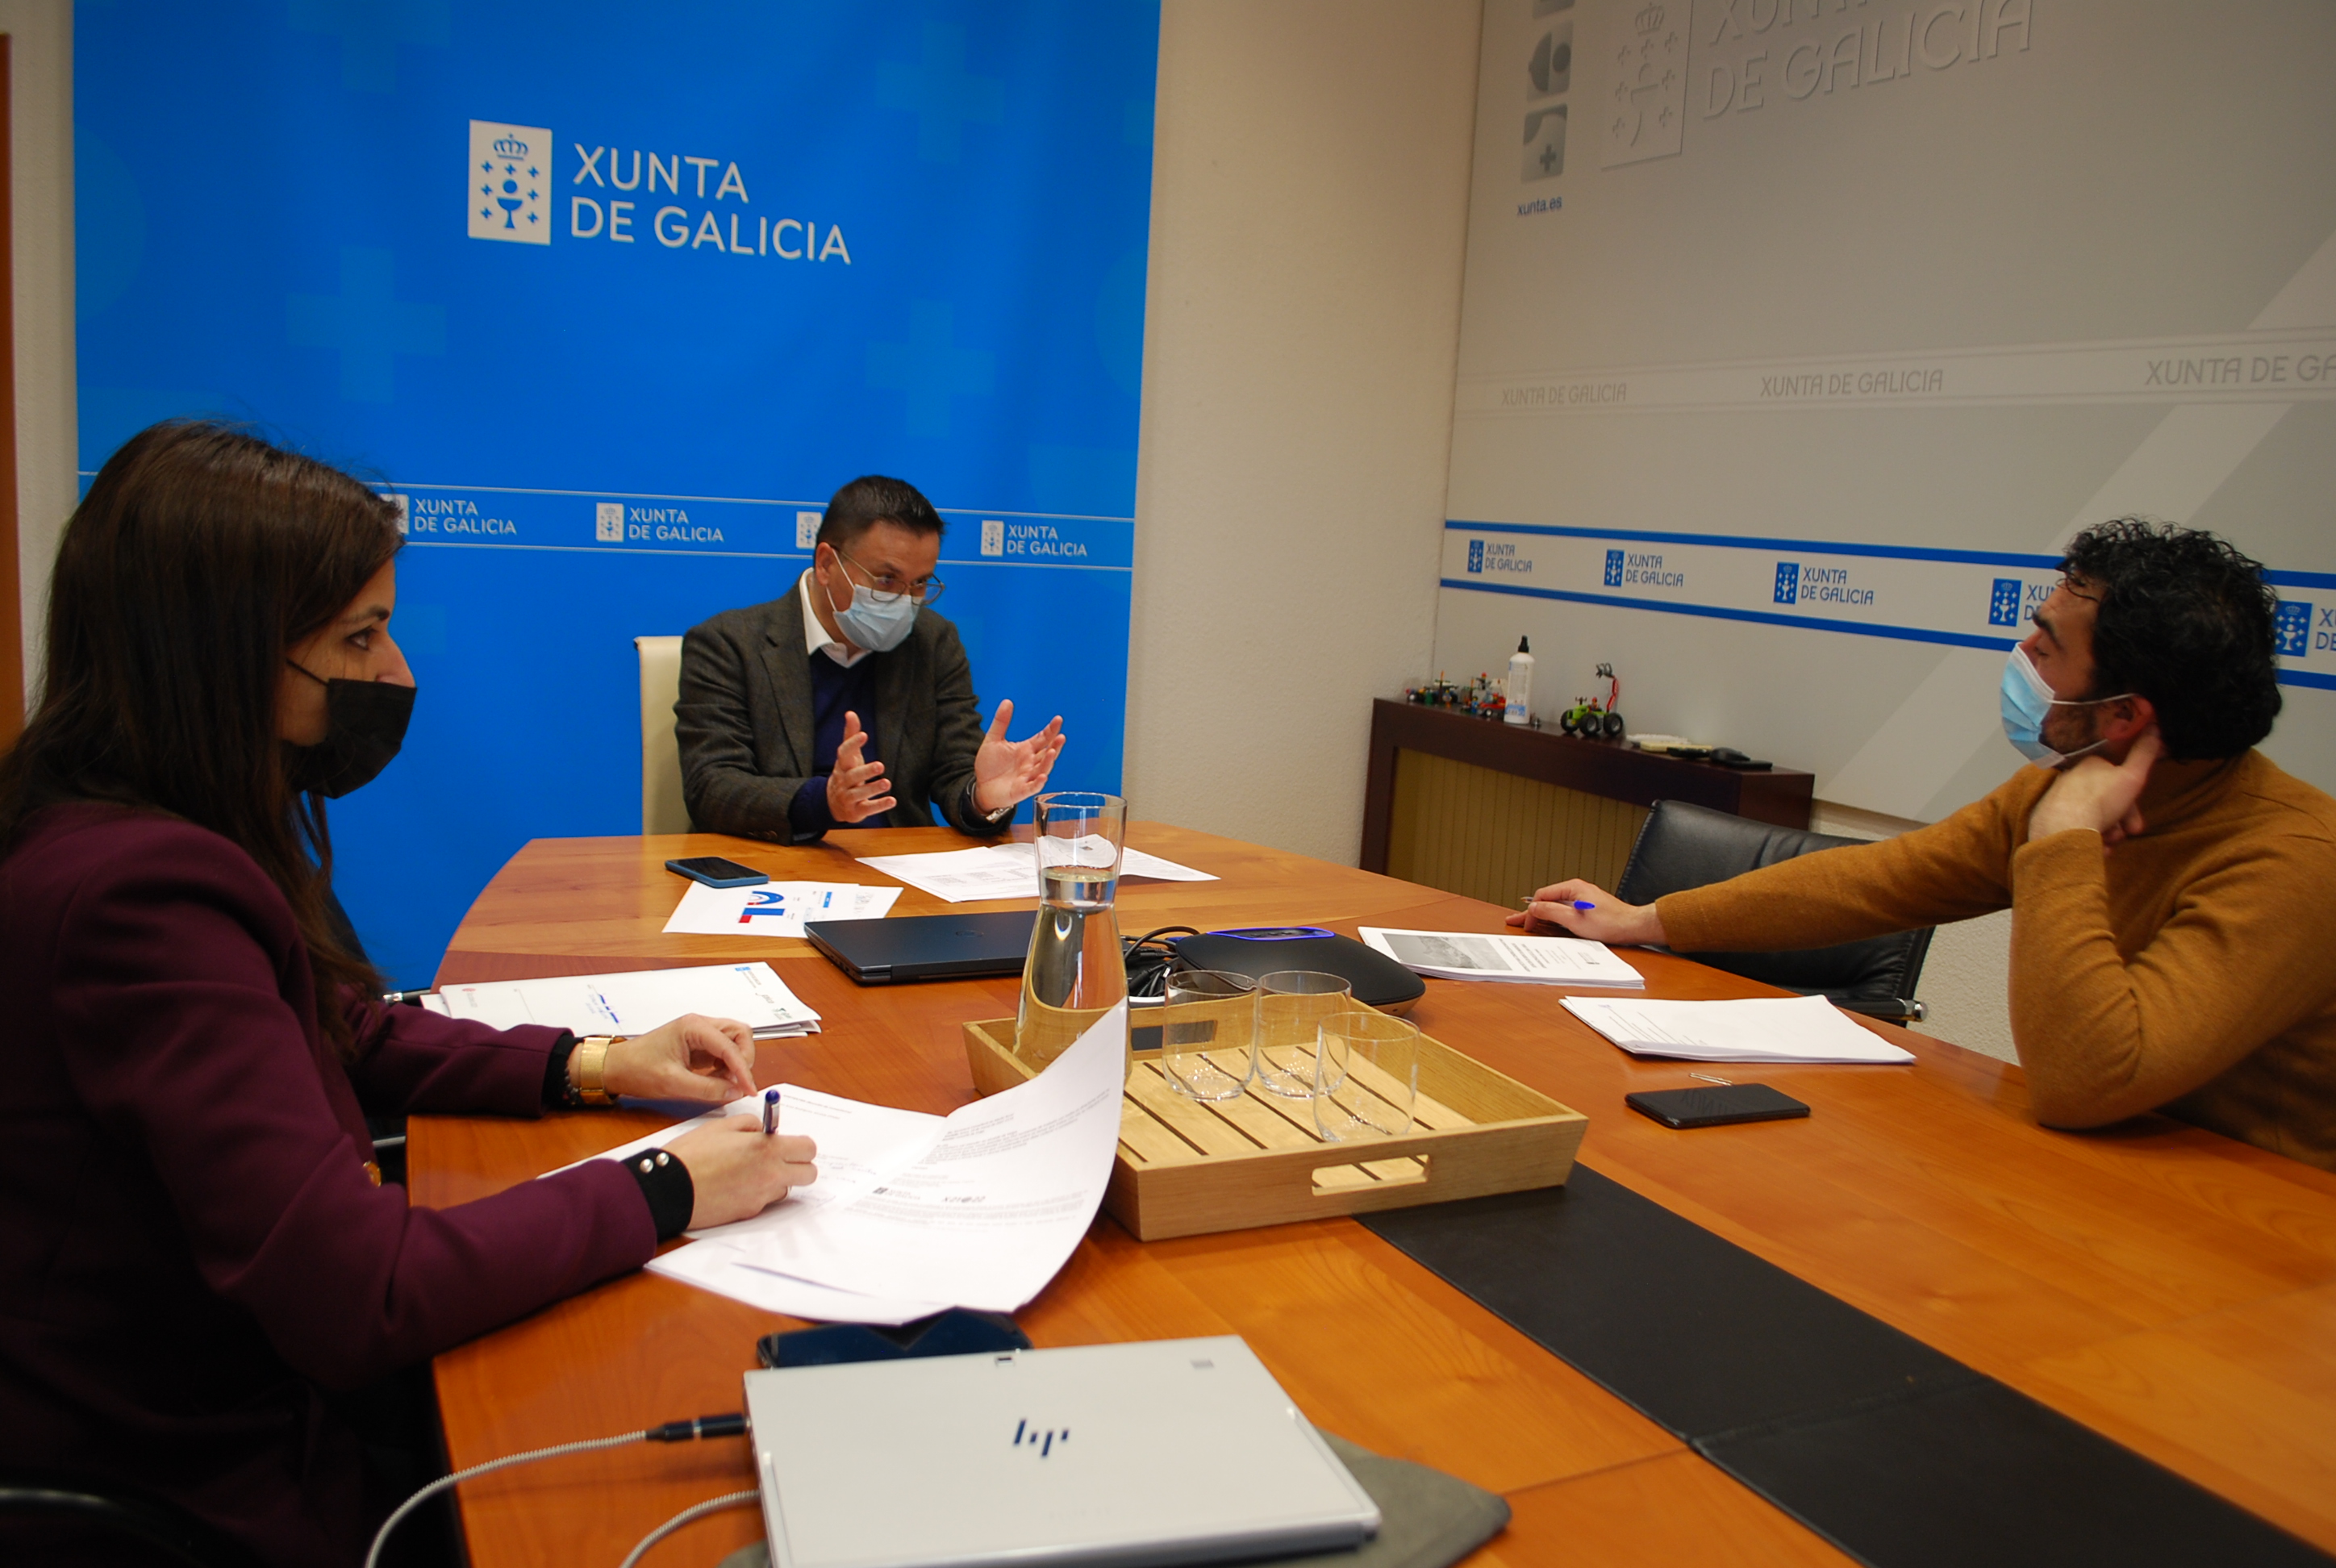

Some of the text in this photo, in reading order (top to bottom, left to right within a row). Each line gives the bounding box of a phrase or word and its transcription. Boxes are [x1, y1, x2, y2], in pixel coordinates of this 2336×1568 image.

[1704, 51, 1768, 122] DE
[1783, 0, 2033, 102] GALICIA
[573, 143, 749, 203] XUNTA
[1517, 196, 1562, 216] xunta.es
[570, 196, 852, 265] DE GALICIA
[2144, 357, 2242, 386] XUNTA
[2250, 356, 2289, 383] DE
[1760, 369, 1943, 397] XUNTA DE GALICIA
[1501, 382, 1627, 406] XUNTA DE GALICIA
[415, 498, 478, 516] XUNTA
[629, 507, 690, 525] XUNTA
[414, 515, 518, 536] DE GALICIA
[628, 523, 725, 543] DE GALICIA
[1008, 524, 1058, 540] XUNTA
[1007, 540, 1088, 557] DE GALICIA
[1487, 543, 1515, 557] XUNTA
[1485, 557, 1533, 573] DE GALICIA
[1628, 553, 1662, 569] XUNTA
[1625, 569, 1683, 587] DE GALICIA
[1803, 567, 1847, 585] XUNTA
[1800, 585, 1874, 606] DE GALICIA
[1013, 1418, 1070, 1458] hp
